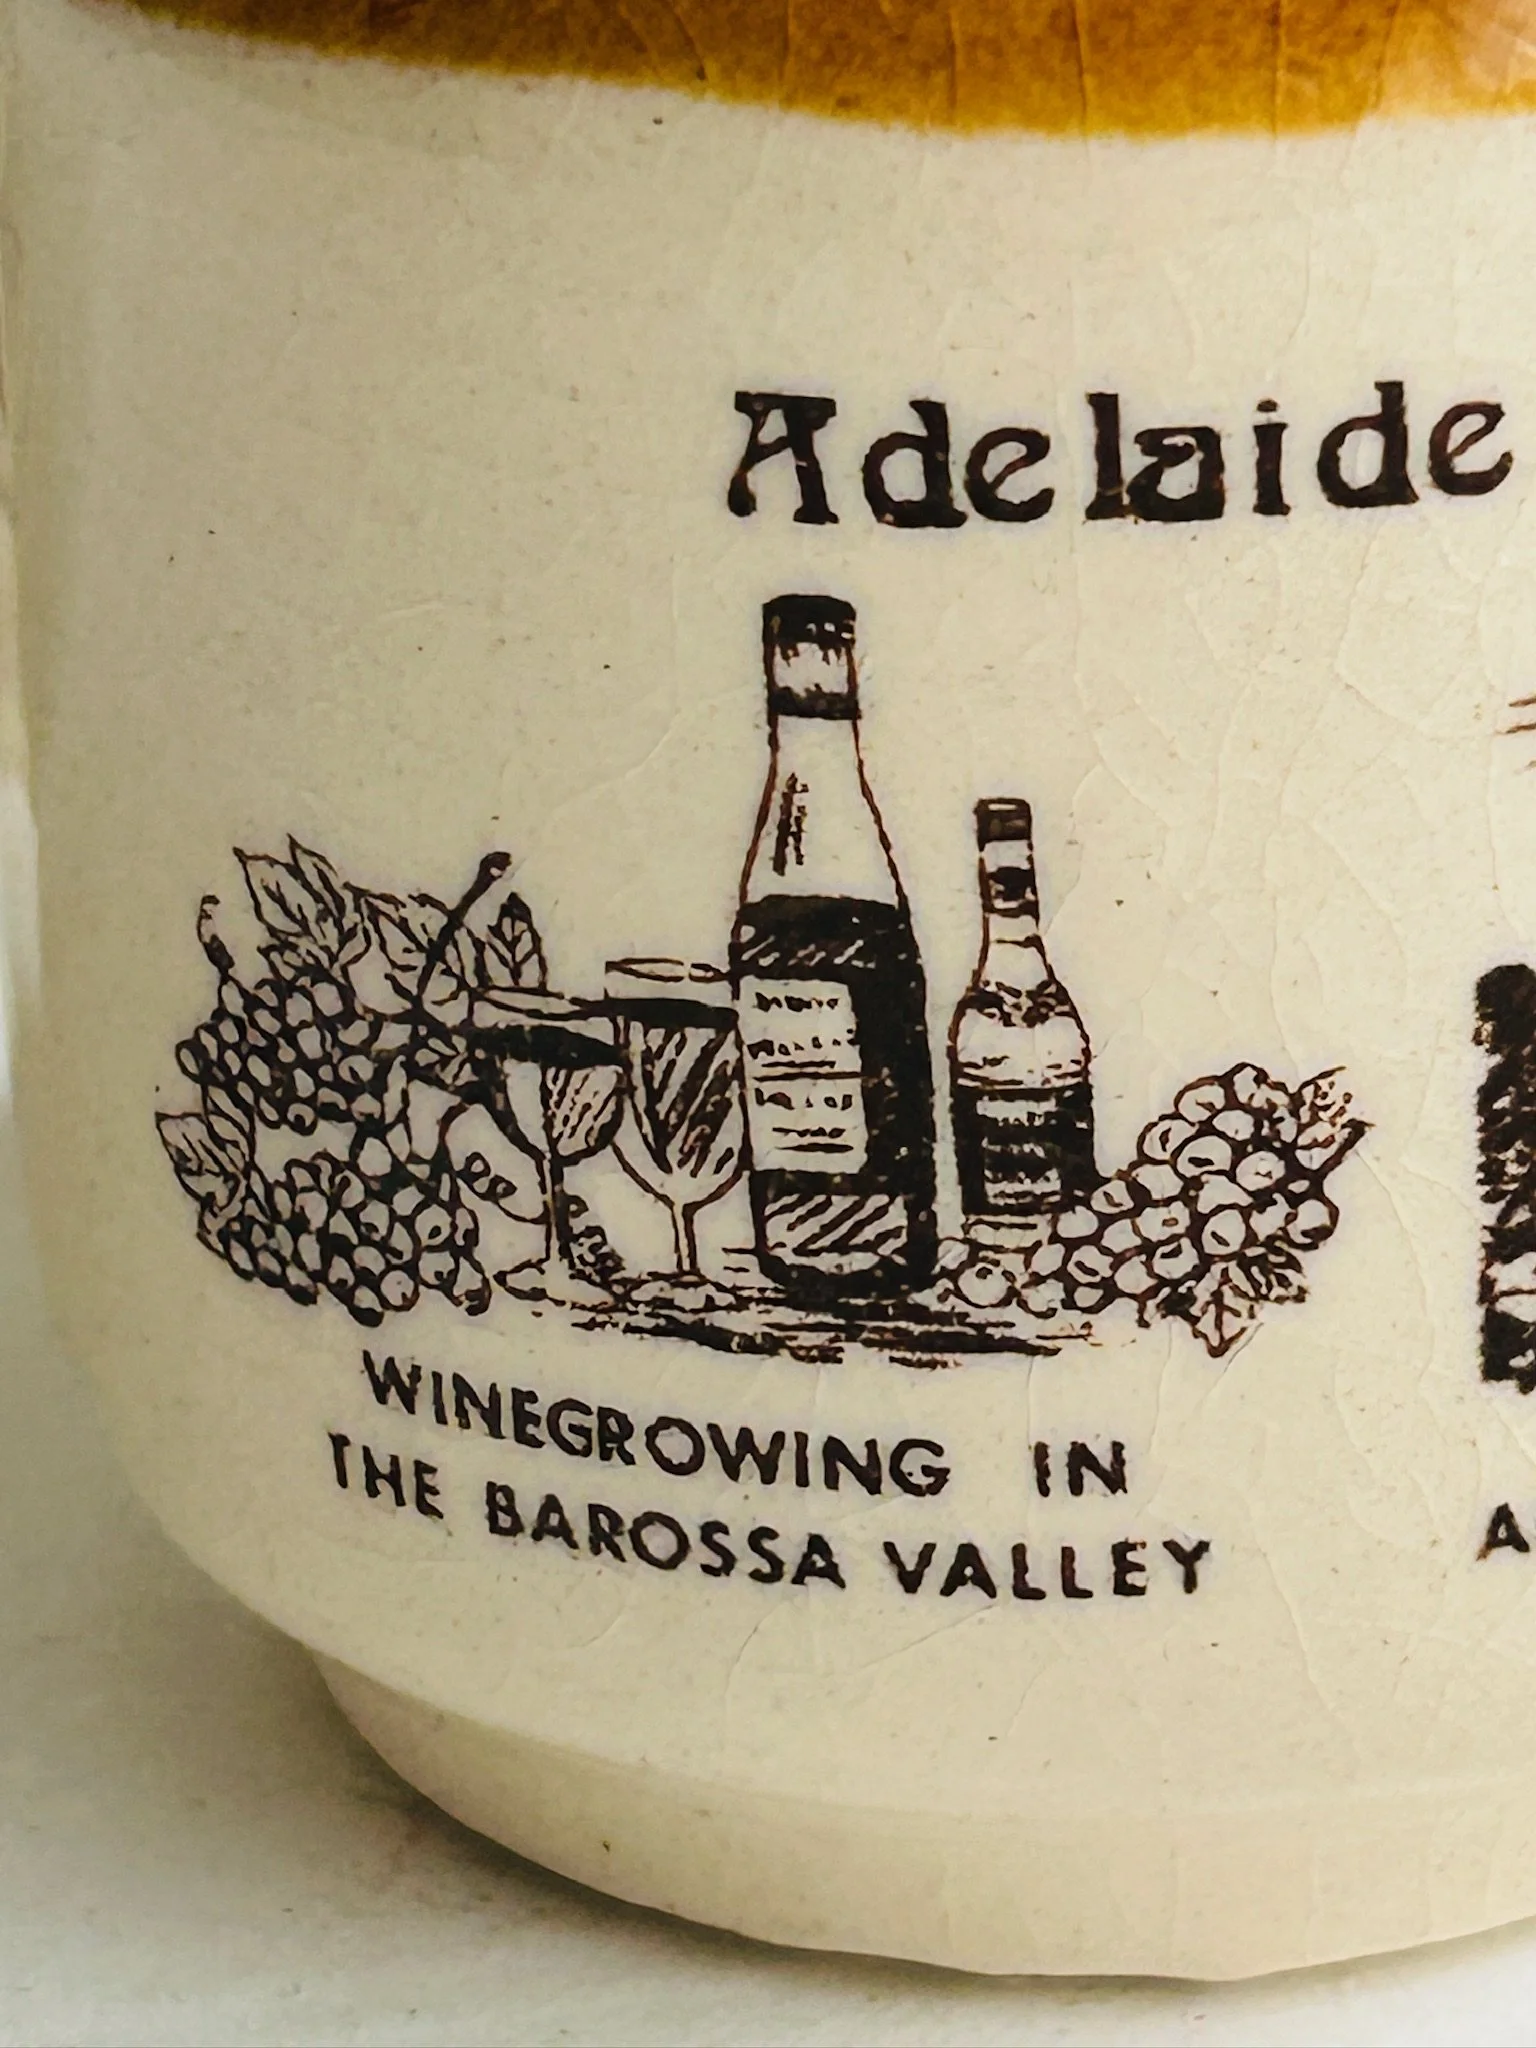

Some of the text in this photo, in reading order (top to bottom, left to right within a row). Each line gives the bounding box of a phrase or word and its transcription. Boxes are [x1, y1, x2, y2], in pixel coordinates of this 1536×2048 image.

[726, 380, 1514, 530] Adelaide
[361, 1348, 1128, 1498] WINEGROWING IN
[327, 1431, 1212, 1601] THE BAROSSA VALLEY
